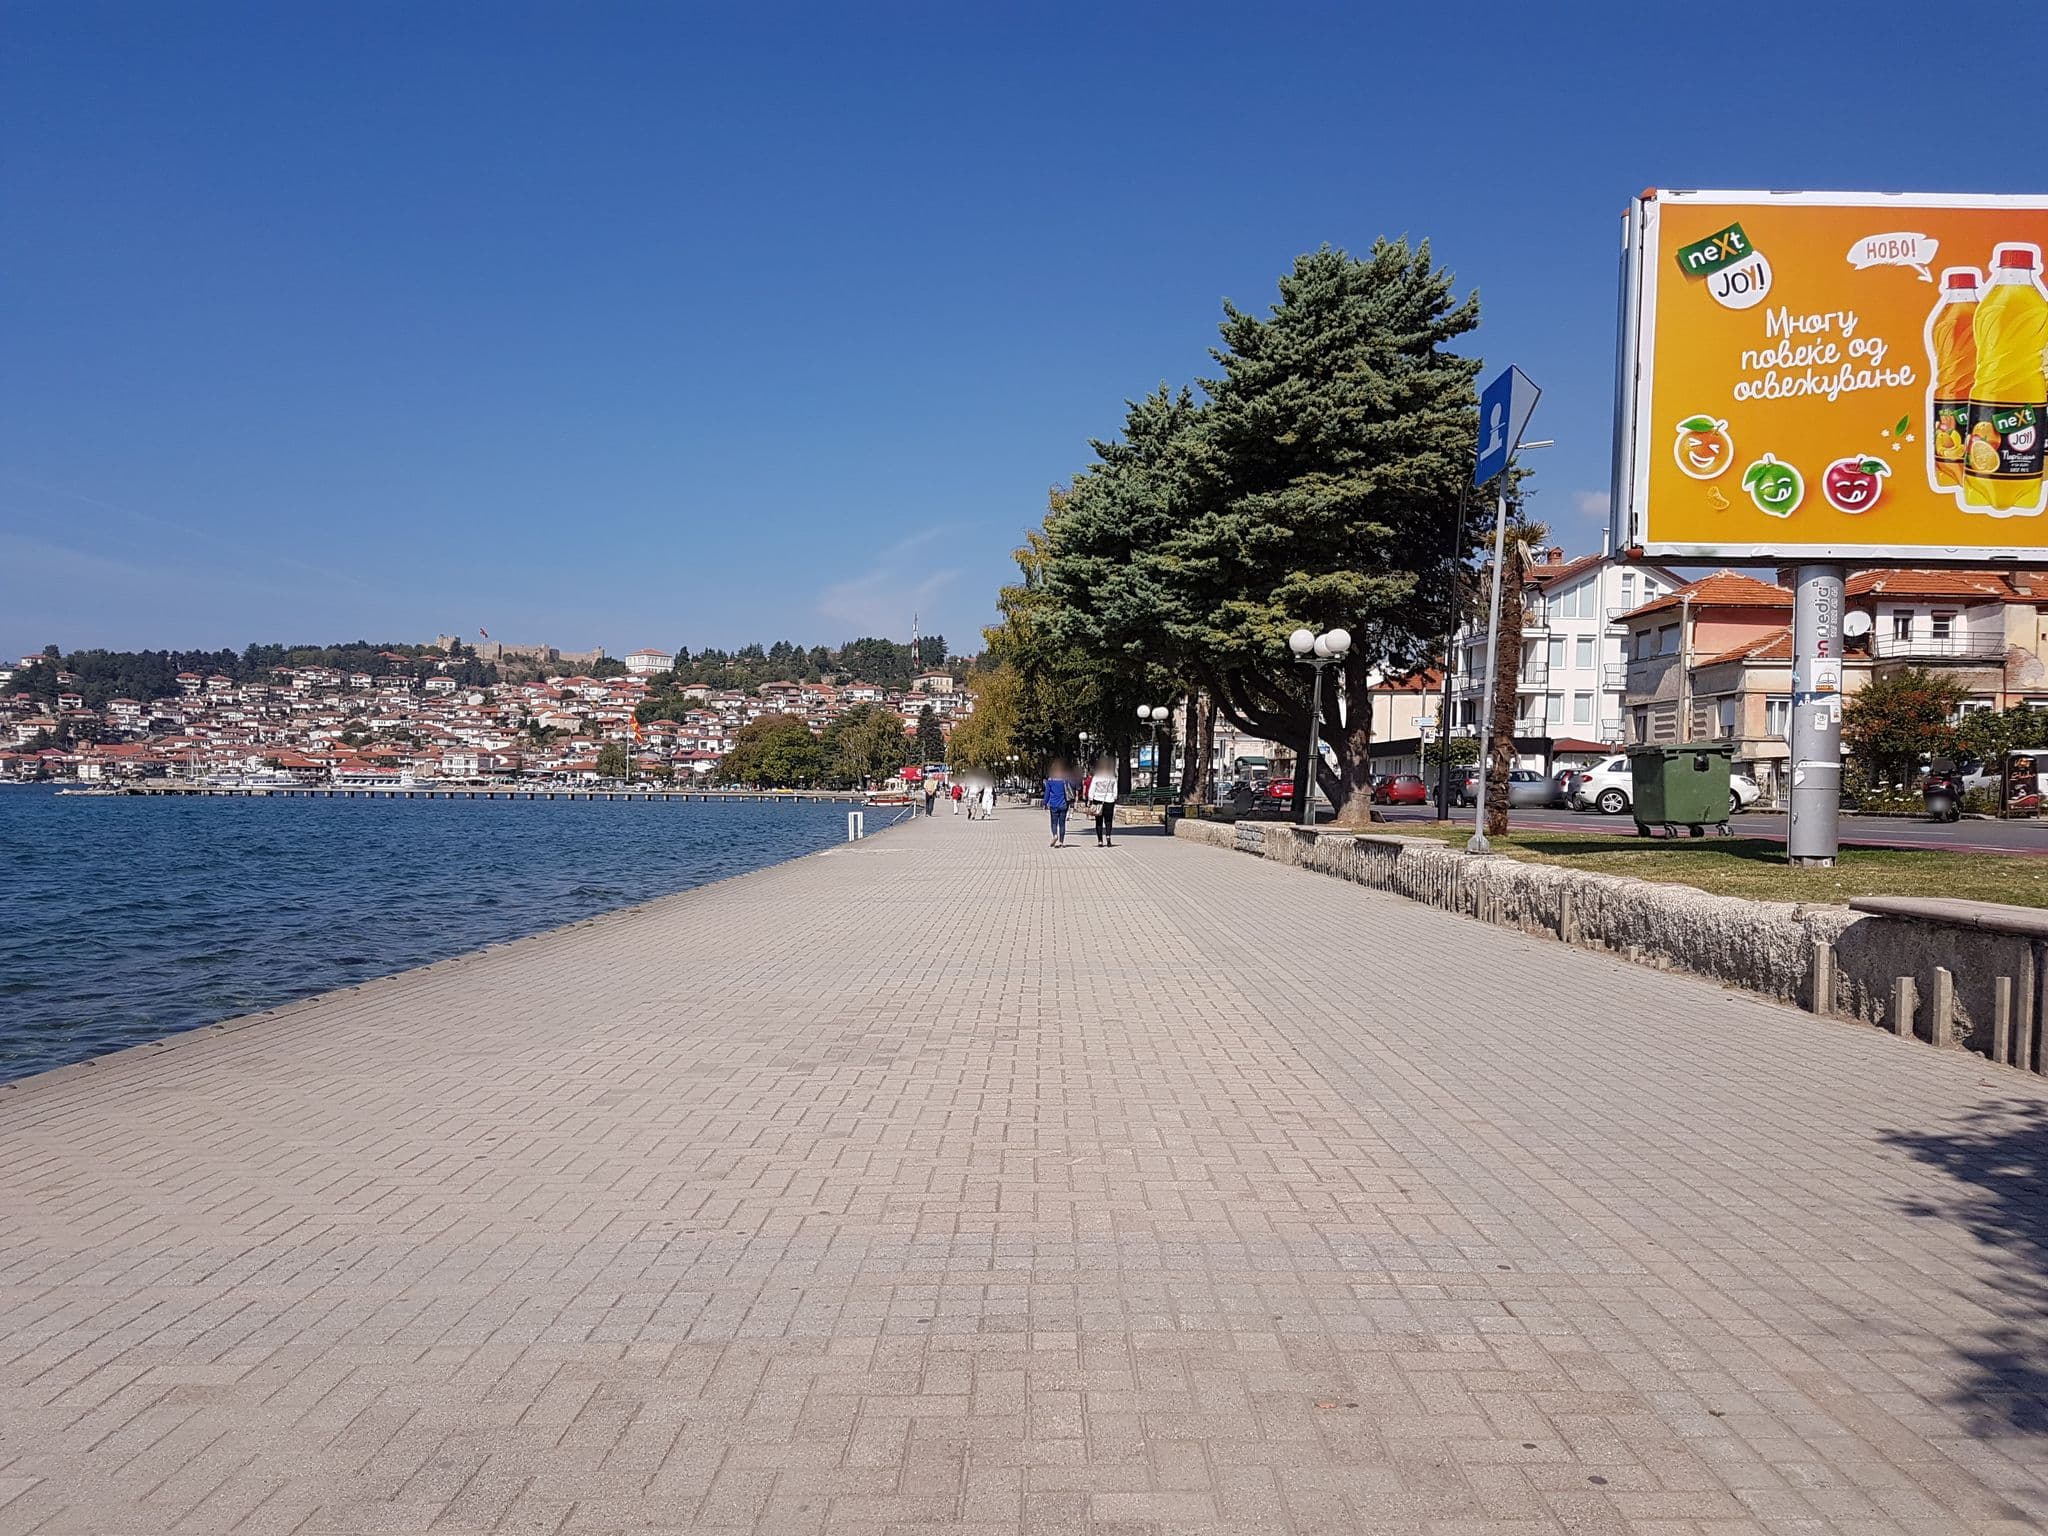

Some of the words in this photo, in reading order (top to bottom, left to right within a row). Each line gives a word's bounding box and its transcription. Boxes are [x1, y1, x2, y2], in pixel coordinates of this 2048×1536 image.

[1866, 239, 1916, 259] НОВО!
[1718, 263, 1765, 297] JOY!
[1766, 306, 1858, 338] Многу
[1741, 337, 1841, 370] повеќе
[1849, 337, 1889, 367] од
[1733, 363, 1917, 402] освежување
